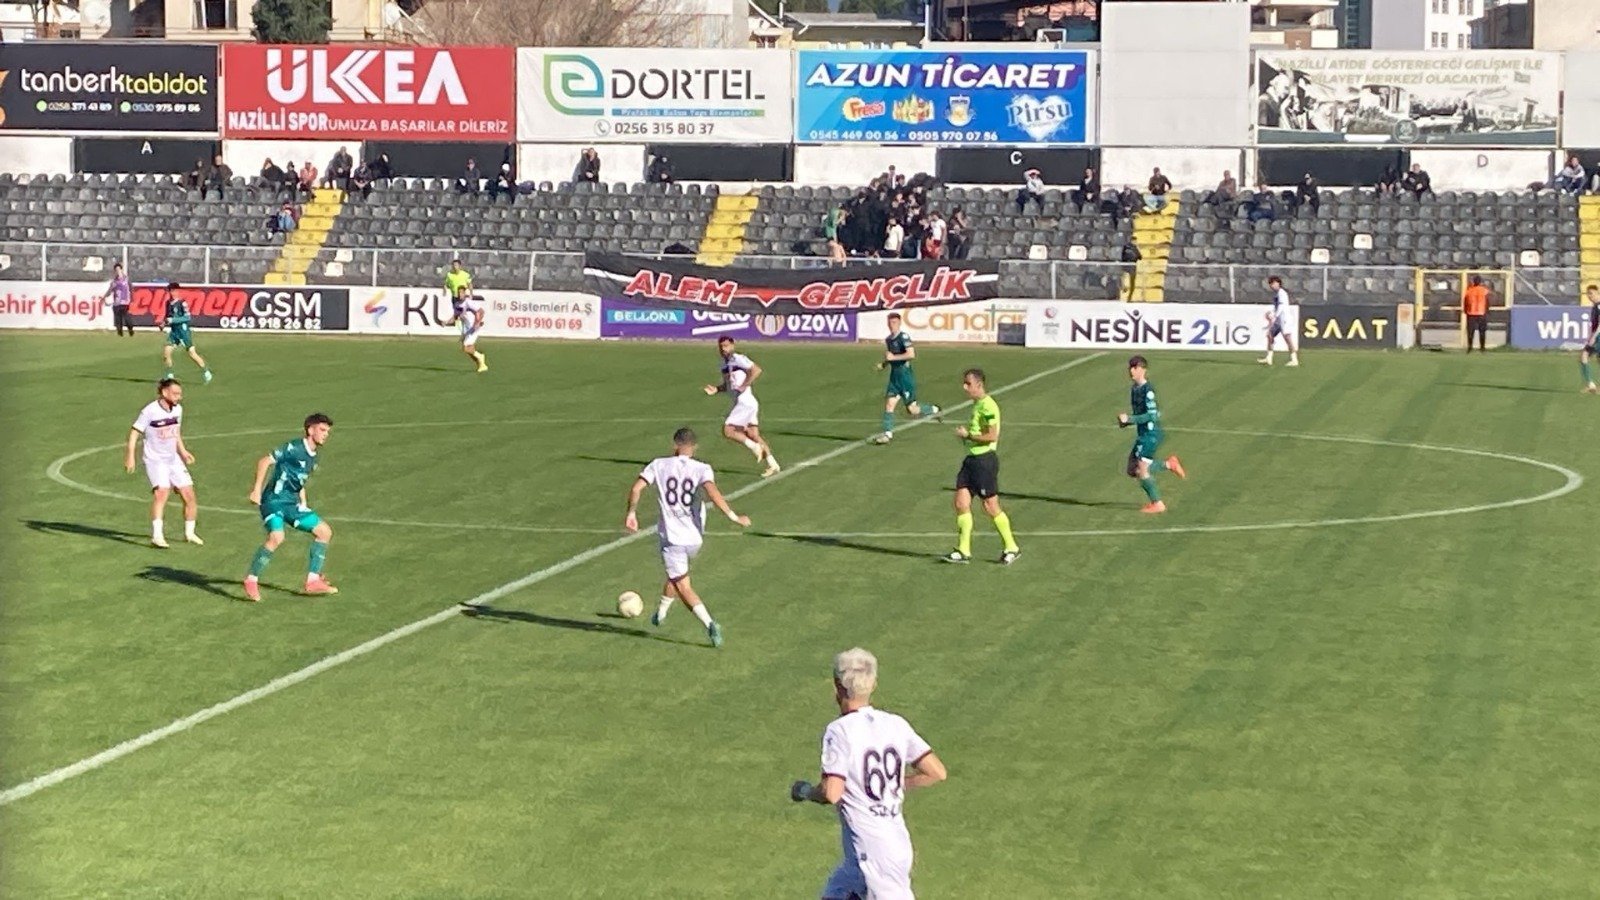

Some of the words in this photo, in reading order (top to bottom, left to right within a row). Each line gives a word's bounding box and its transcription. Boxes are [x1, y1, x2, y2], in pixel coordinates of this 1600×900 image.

[806, 62, 912, 89] AZUN
[921, 56, 1076, 89] TİCARET
[1464, 58, 1521, 71] GELİŞME
[611, 68, 765, 99] DORTEL
[1366, 72, 1424, 84] MERKEZİ
[228, 106, 286, 131] NAZİLLİ
[380, 119, 455, 133] BAŞARILAR
[459, 118, 508, 133] DİLERİZ
[1008, 101, 1071, 125] Pirsu
[614, 122, 648, 135] 0256
[652, 122, 674, 135] 315
[677, 122, 695, 135] 80
[698, 122, 715, 135] 37
[809, 130, 838, 140] 0545
[841, 130, 863, 140] 469
[865, 130, 882, 140] 00
[908, 131, 940, 141] 0505
[941, 131, 963, 141] 970
[966, 131, 981, 141] 07
[141, 140, 153, 155] A
[1010, 150, 1023, 166] C
[1477, 153, 1489, 168] D
[623, 269, 738, 308] ALEM
[797, 266, 978, 309] GENÇLİK
[42, 294, 104, 322] Koleji
[250, 291, 321, 317] GSM
[510, 301, 569, 313] Sistemleri
[219, 316, 255, 329] 0543
[258, 317, 281, 329] 918
[284, 317, 301, 330] 26
[304, 317, 321, 330] 82
[507, 316, 532, 328] 0531
[533, 317, 553, 330] 910
[555, 318, 566, 330] 61
[568, 318, 582, 331] 69
[613, 310, 678, 323] BELLONA
[1304, 318, 1388, 340] SAAT
[665, 476, 694, 507] 88
[863, 746, 902, 802] 69
